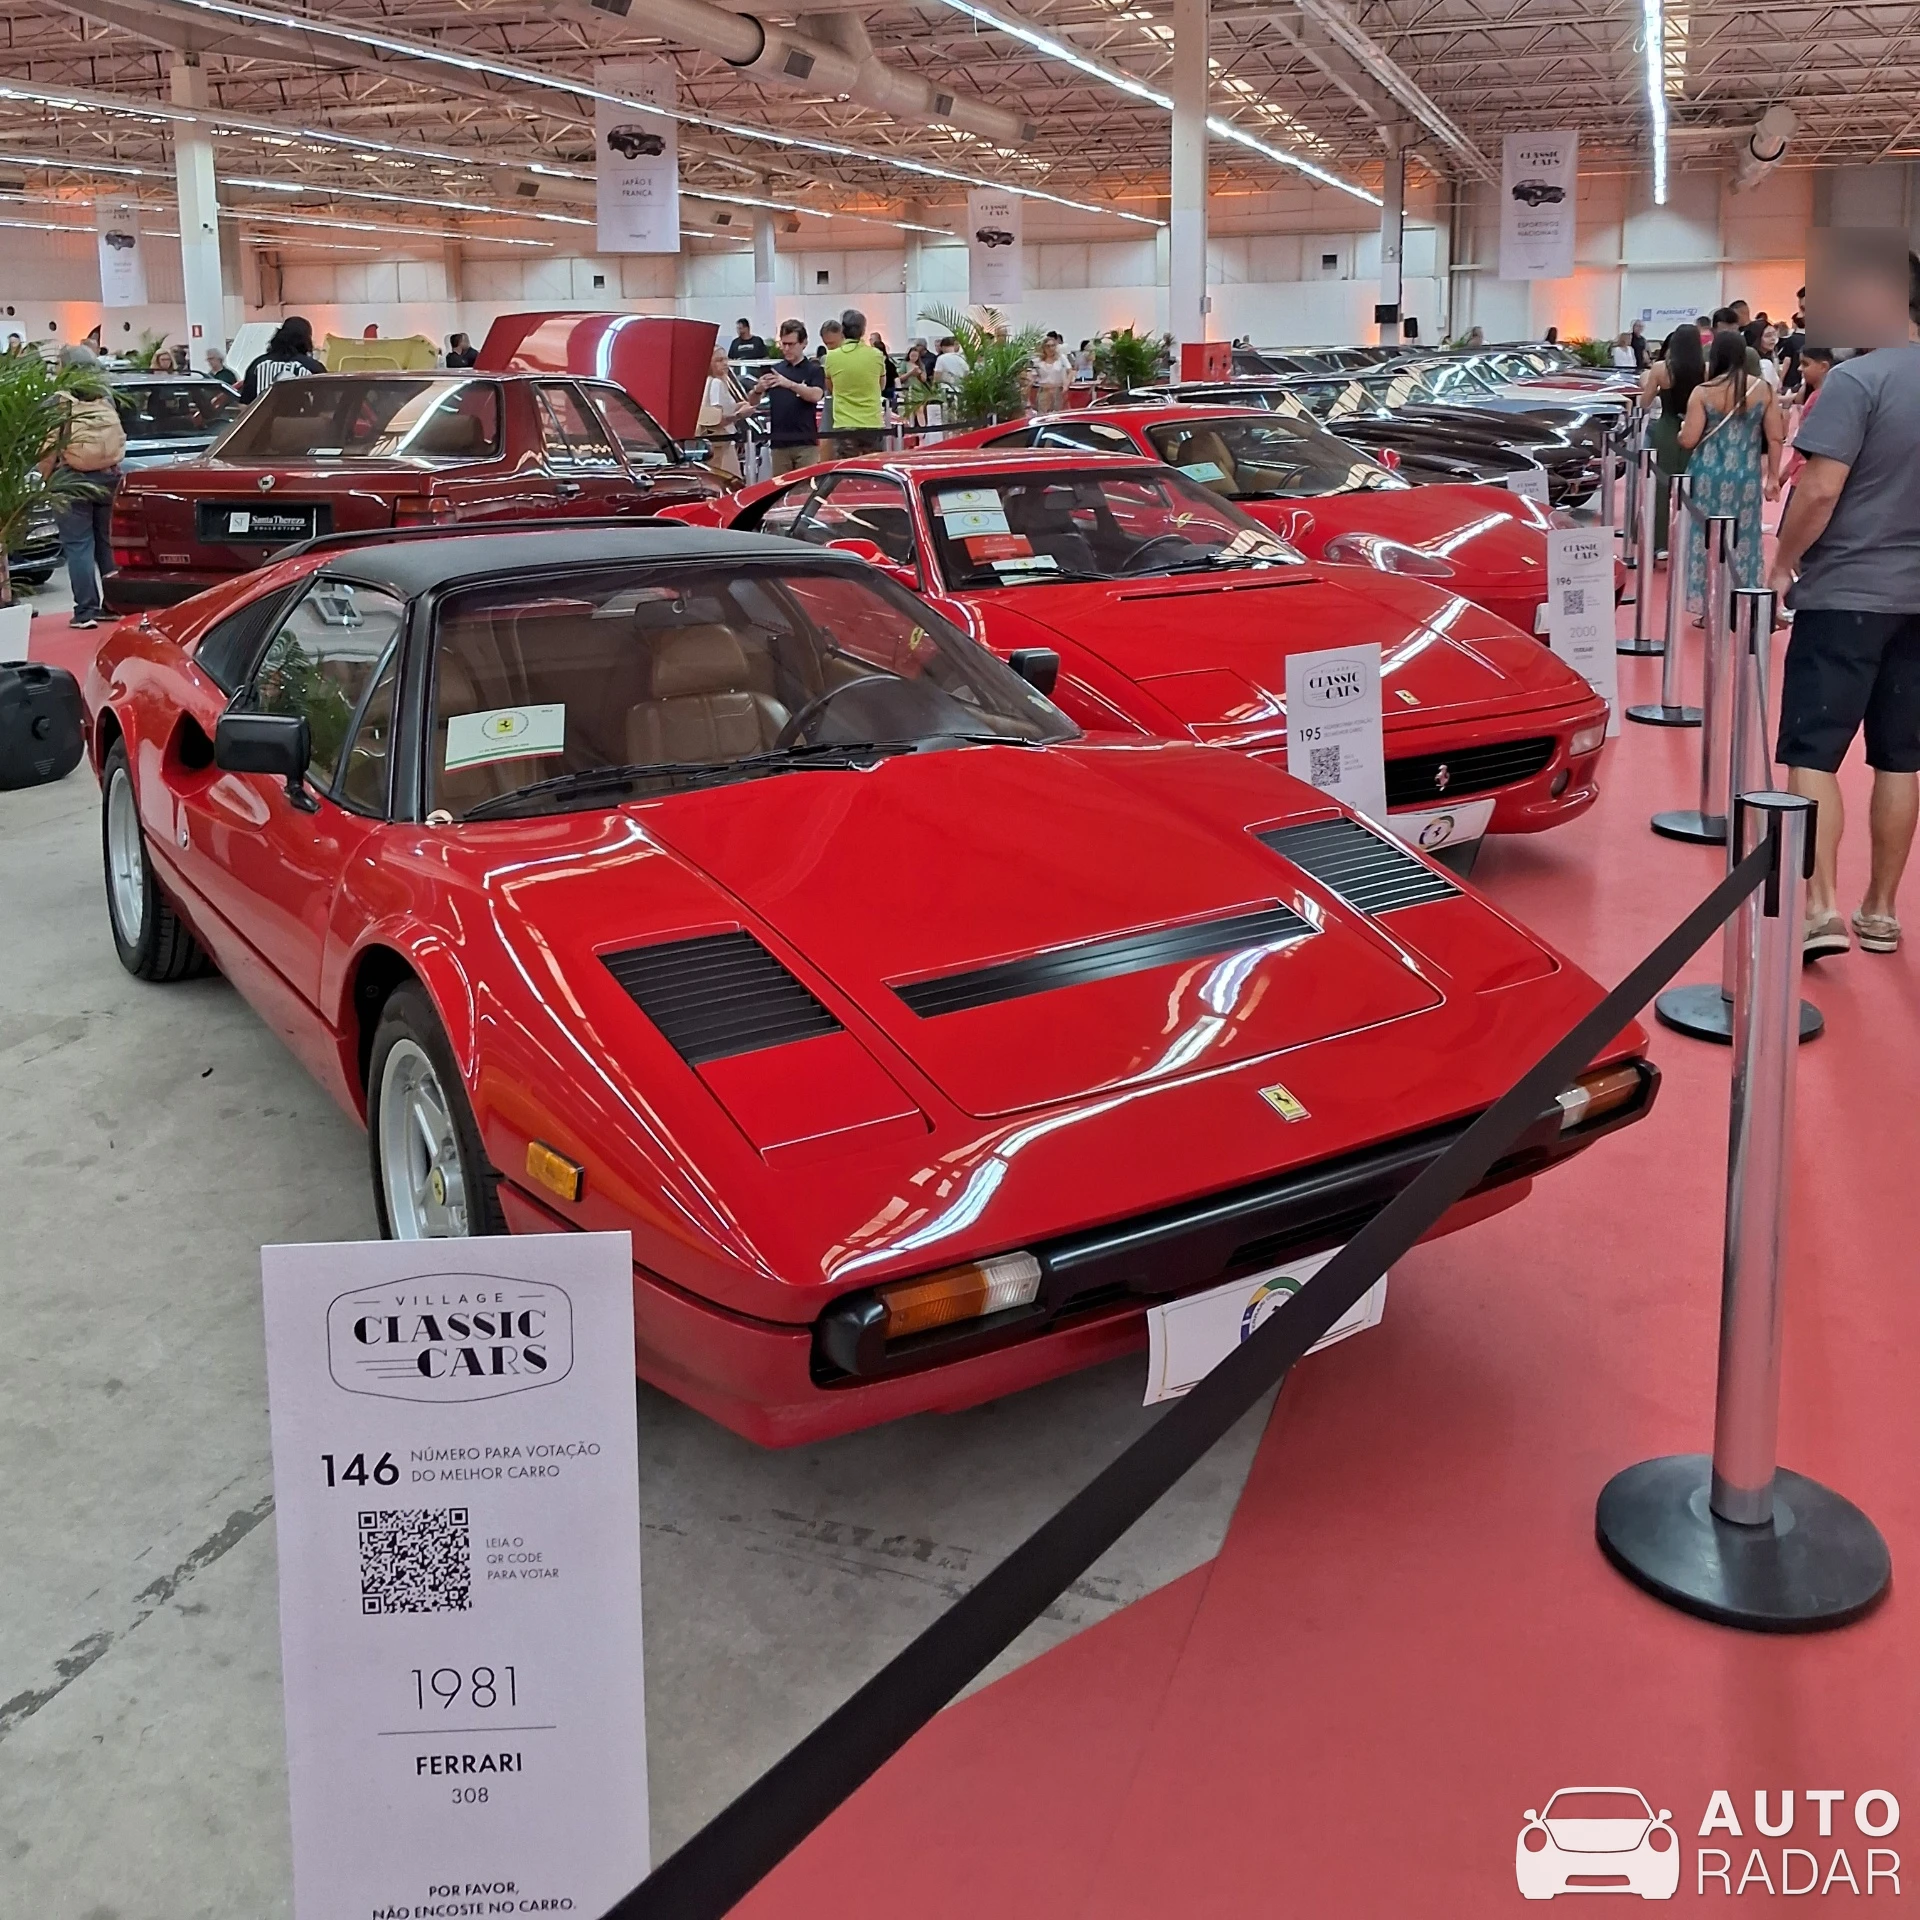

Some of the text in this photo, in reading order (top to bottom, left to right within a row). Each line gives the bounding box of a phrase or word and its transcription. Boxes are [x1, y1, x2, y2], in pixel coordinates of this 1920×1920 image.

[1563, 543, 1598, 552] CLASSIC
[1556, 577, 1572, 586] 196
[1570, 625, 1597, 639] 2000
[1309, 671, 1360, 689] CLASSIC
[1325, 684, 1360, 700] CARS
[1300, 726, 1321, 742] 195
[396, 1292, 504, 1306] VILLAGE
[354, 1309, 547, 1345] CLASSIC
[417, 1344, 548, 1378] CARS
[411, 1440, 601, 1462] NÚMERO PARA VOTAÇÃO
[321, 1452, 400, 1488] 146
[412, 1465, 560, 1482] DO MELHOR CARRO
[486, 1537, 524, 1548] LEIA O
[486, 1552, 543, 1564] QR CODE
[487, 1568, 559, 1580] PARA VOTAR
[411, 1666, 517, 1710] 1981
[415, 1753, 522, 1776] FERRARI
[451, 1788, 490, 1804] 308
[429, 1881, 520, 1898] POR FAVOR,
[372, 1898, 577, 1920] NÃO ENCOSTE NO CARRO.
